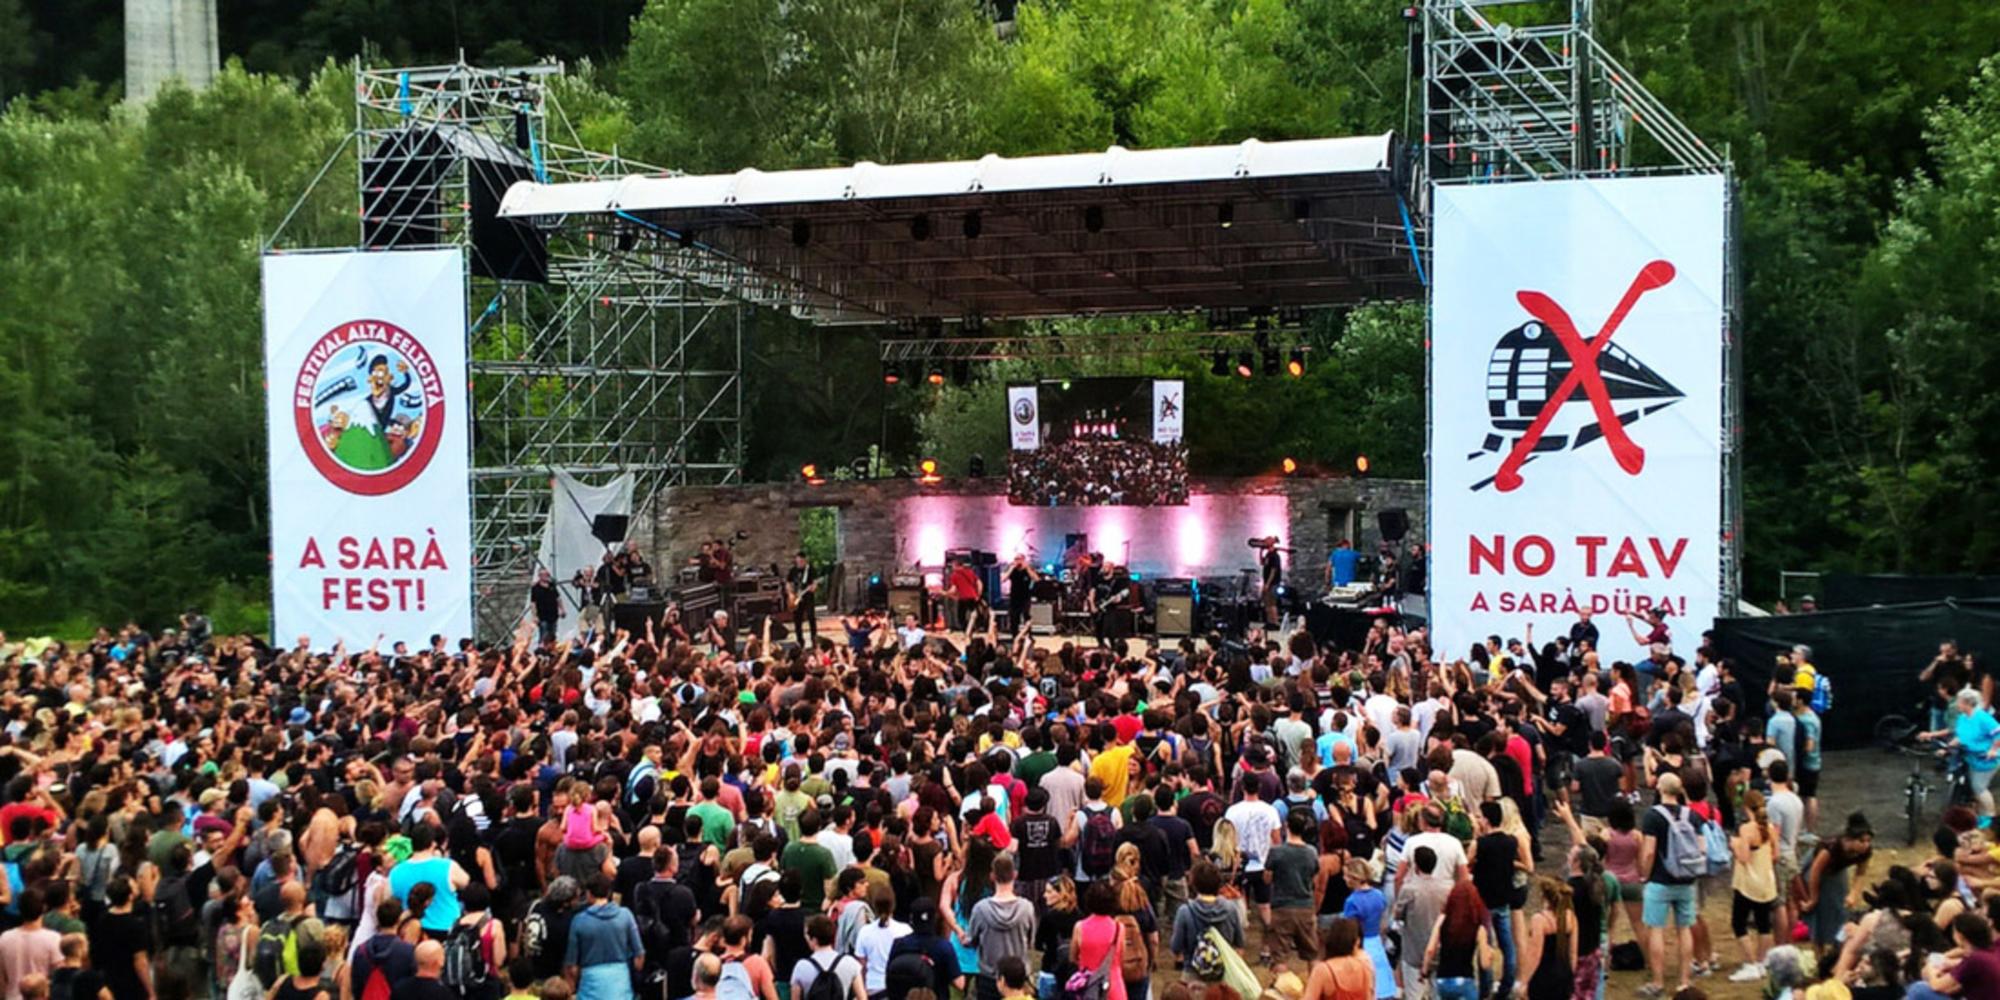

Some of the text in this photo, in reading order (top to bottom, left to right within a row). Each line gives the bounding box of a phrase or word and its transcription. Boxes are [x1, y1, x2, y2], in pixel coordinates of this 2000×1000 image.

[296, 324, 444, 408] FESTIVAL ALTA FELICITÀ
[299, 527, 449, 570] A SARÀ
[1468, 534, 1690, 580] NO TAV
[322, 577, 426, 612] FEST!
[1470, 587, 1687, 618] A SARÀ DÜRA!
